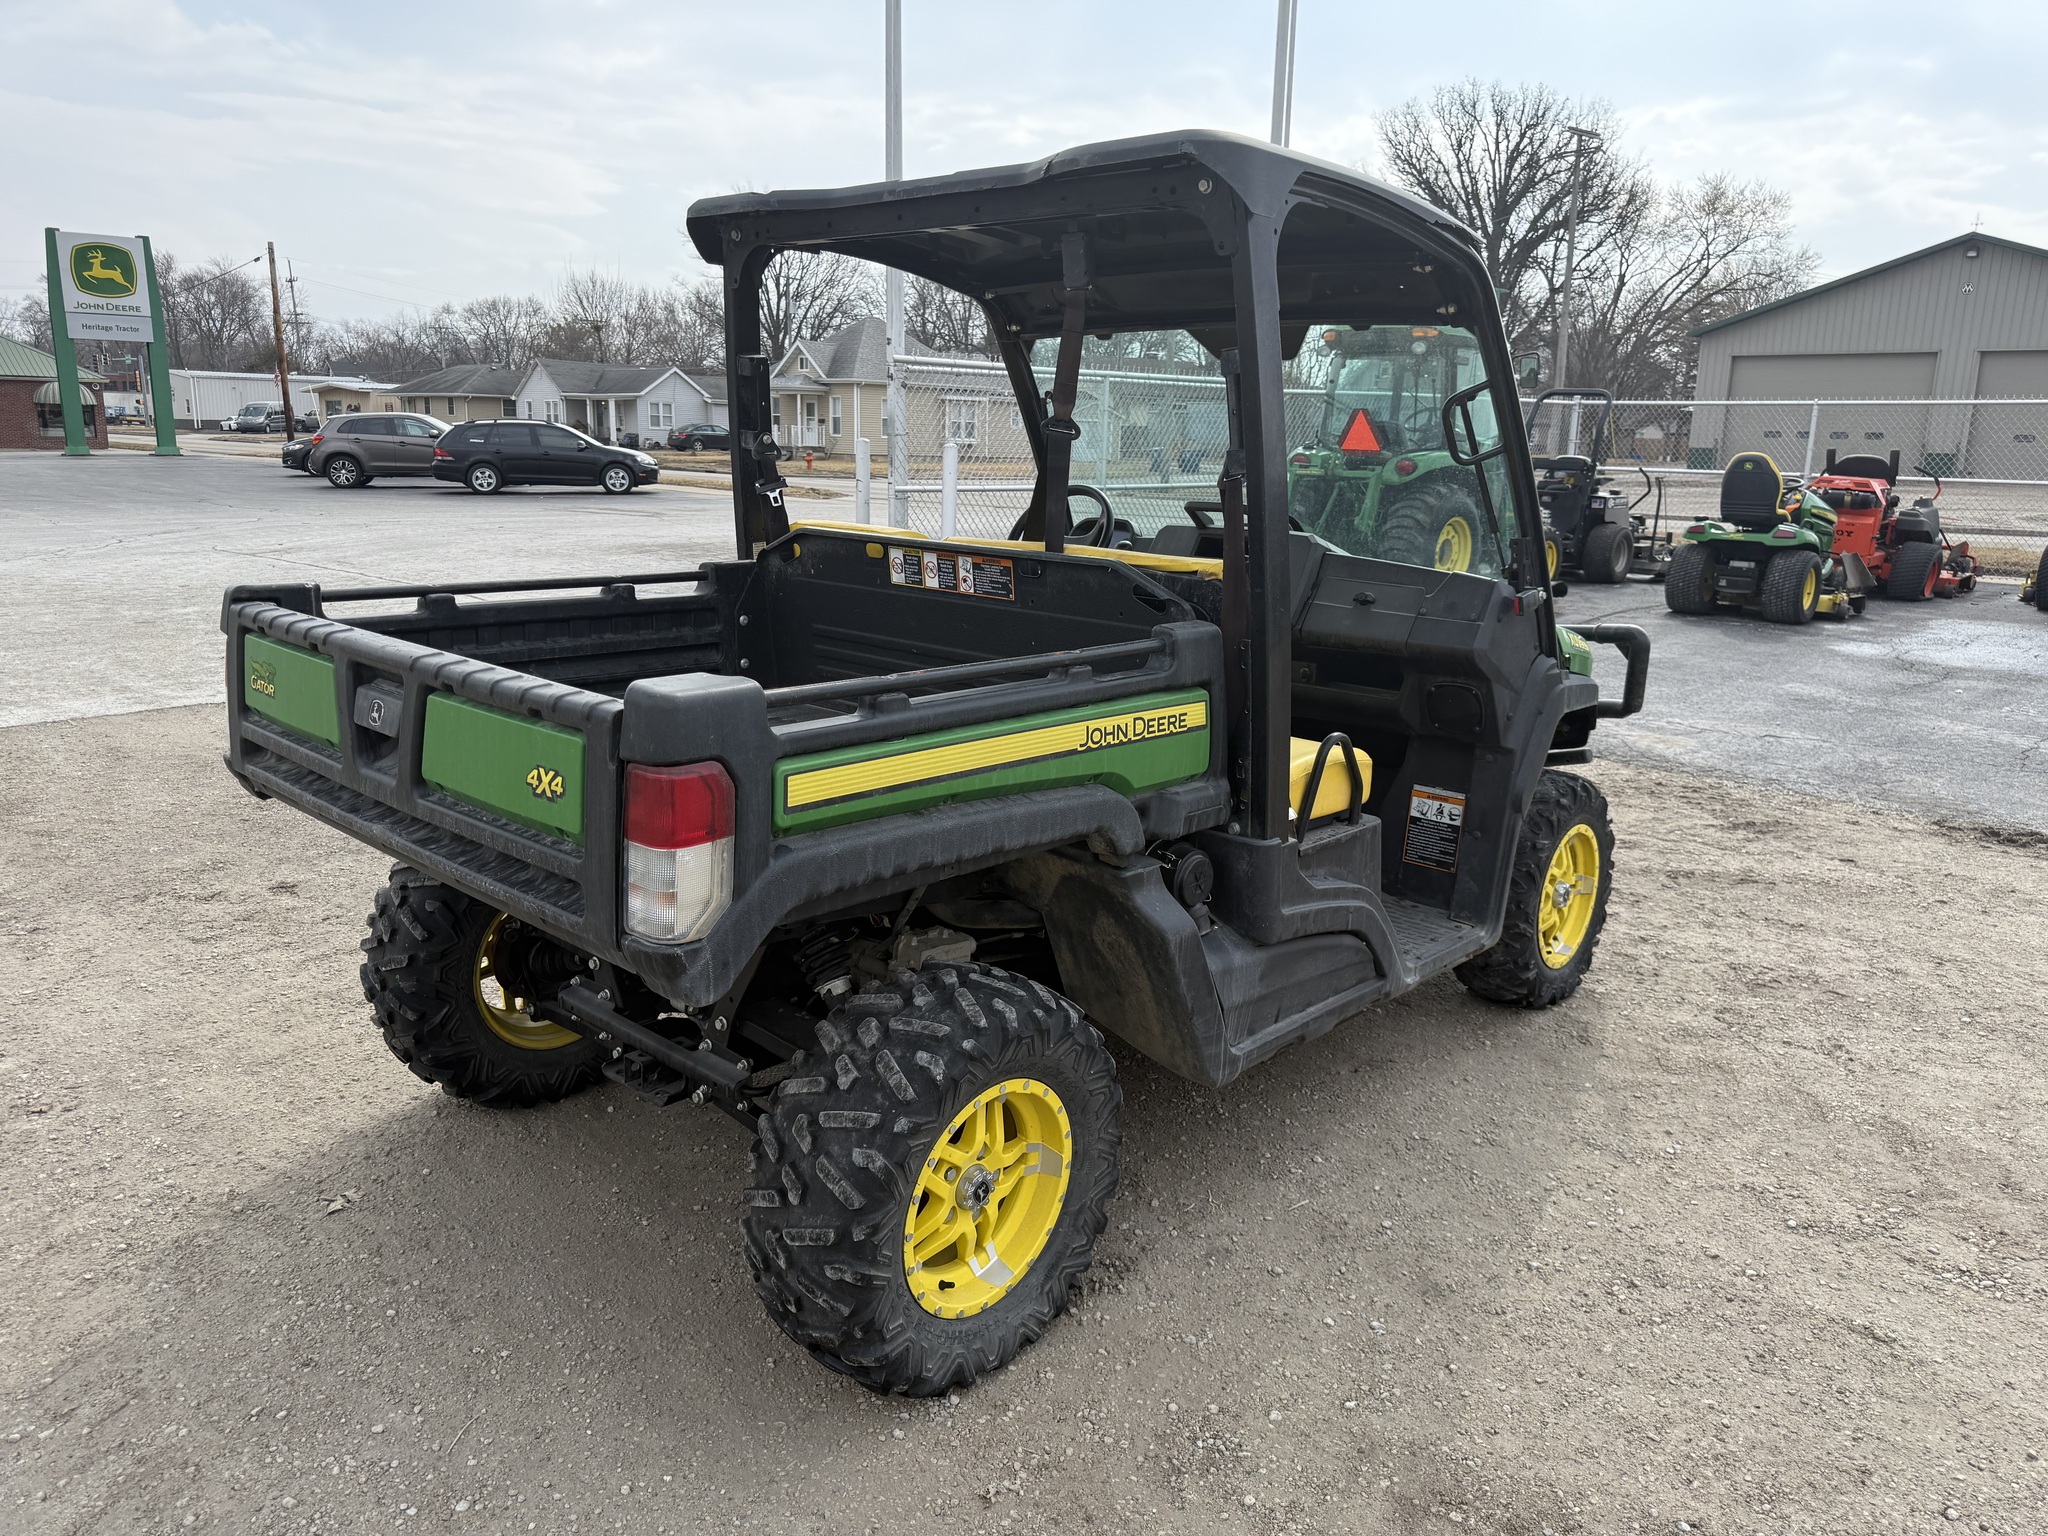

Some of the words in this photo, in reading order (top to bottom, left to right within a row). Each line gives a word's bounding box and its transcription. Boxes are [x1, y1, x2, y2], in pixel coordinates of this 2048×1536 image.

[73, 301, 105, 311] JOHN
[105, 302, 142, 313] DEERE
[81, 323, 113, 332] Heritage
[115, 325, 140, 333] Tractor
[250, 674, 275, 697] GATOR
[1078, 722, 1129, 750] JOHN
[1132, 712, 1188, 740] DEERE
[526, 767, 564, 798] 4X4
